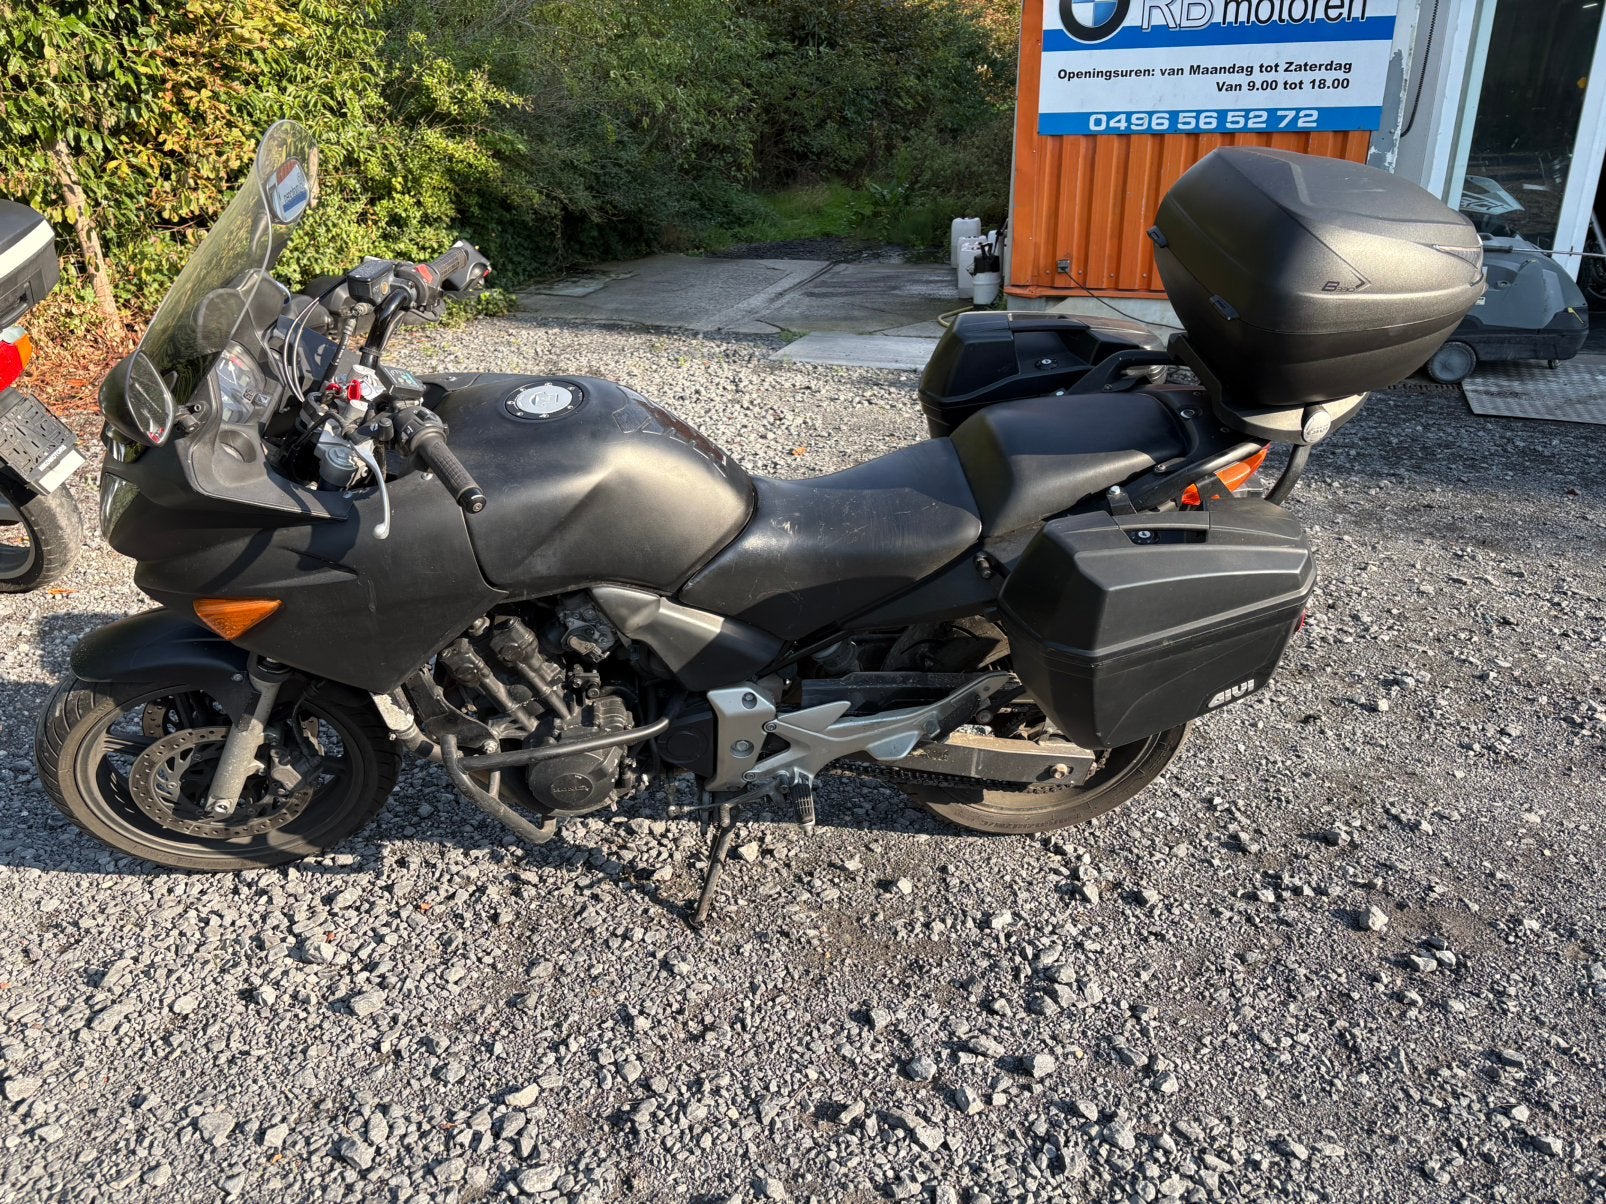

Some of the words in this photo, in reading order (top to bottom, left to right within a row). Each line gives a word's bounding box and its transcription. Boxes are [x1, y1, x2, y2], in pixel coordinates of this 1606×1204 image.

[1057, 67, 1155, 81] Openingsuren:
[1160, 67, 1184, 76] van
[1188, 63, 1254, 76] Maandag
[1259, 62, 1280, 73] tot
[1283, 60, 1352, 74] Zaterdag
[1216, 81, 1242, 92] Van
[1247, 80, 1278, 91] 9.00
[1283, 79, 1304, 90] tot
[1309, 78, 1350, 90] 18.00
[1088, 113, 1170, 131] 0496
[1177, 112, 1218, 130] 56
[1225, 111, 1268, 129] 52
[1276, 109, 1319, 128] 72
